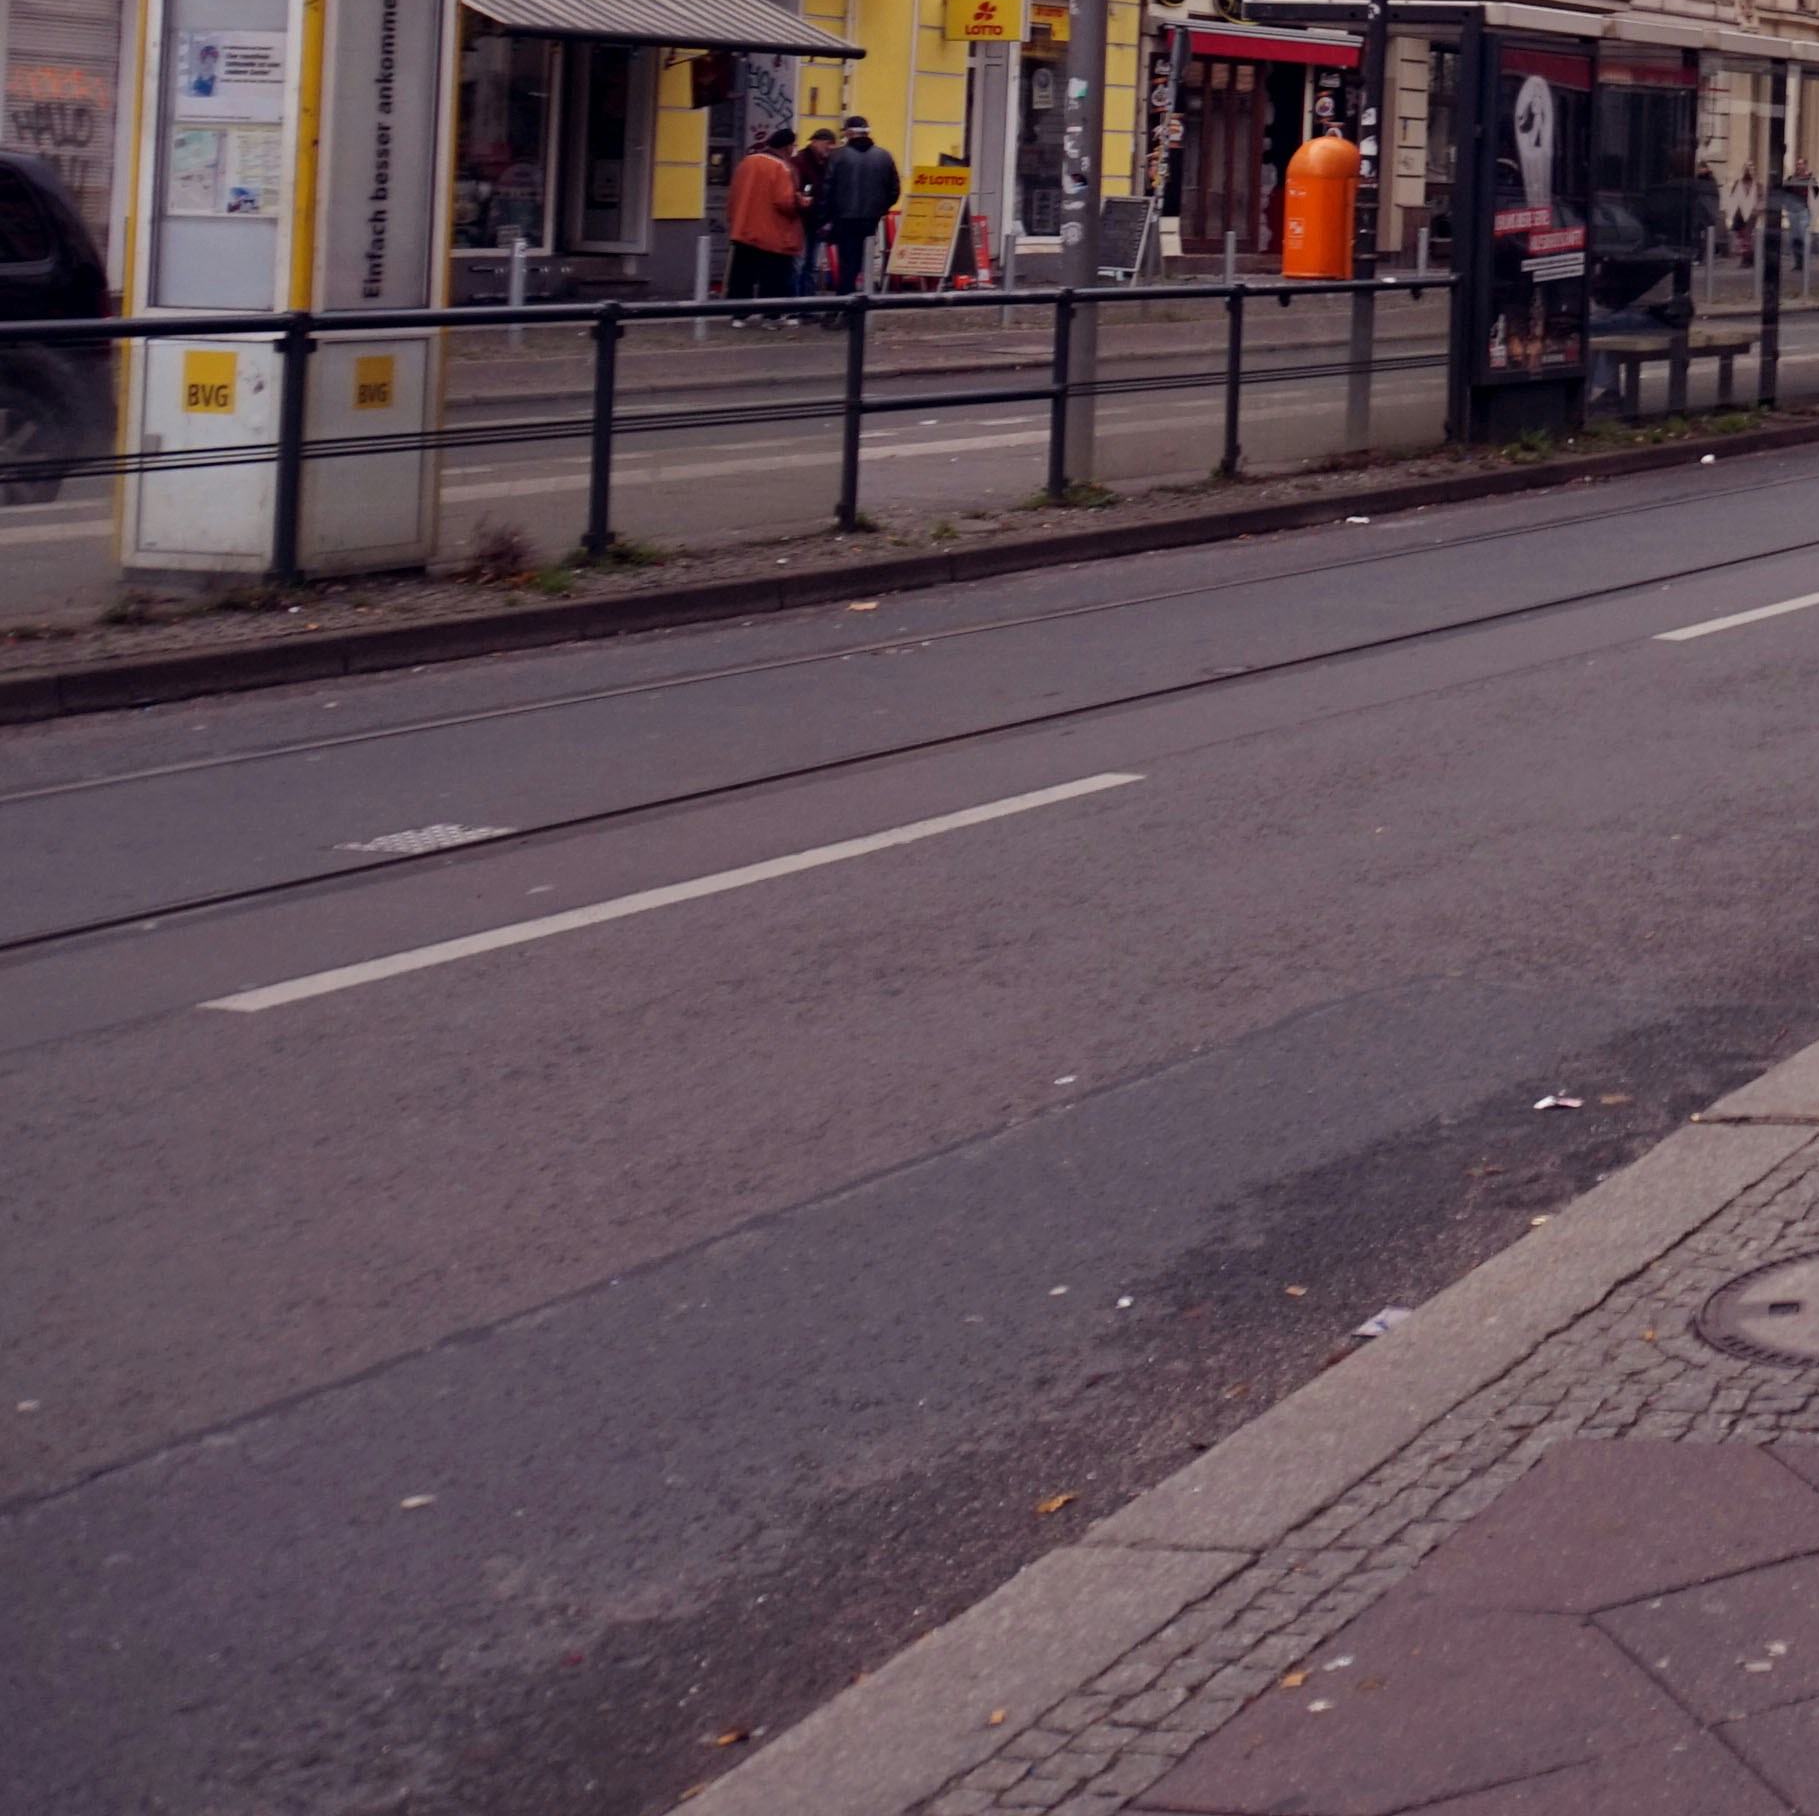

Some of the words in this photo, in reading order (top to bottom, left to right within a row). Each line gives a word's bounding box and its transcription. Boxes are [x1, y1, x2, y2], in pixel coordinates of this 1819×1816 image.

[965, 25, 1003, 36] LOTTO
[370, 122, 391, 202] besser
[929, 175, 966, 185] LOTTO
[362, 209, 387, 299] Einfach
[186, 382, 231, 409] BVG
[357, 382, 390, 405] BVG
